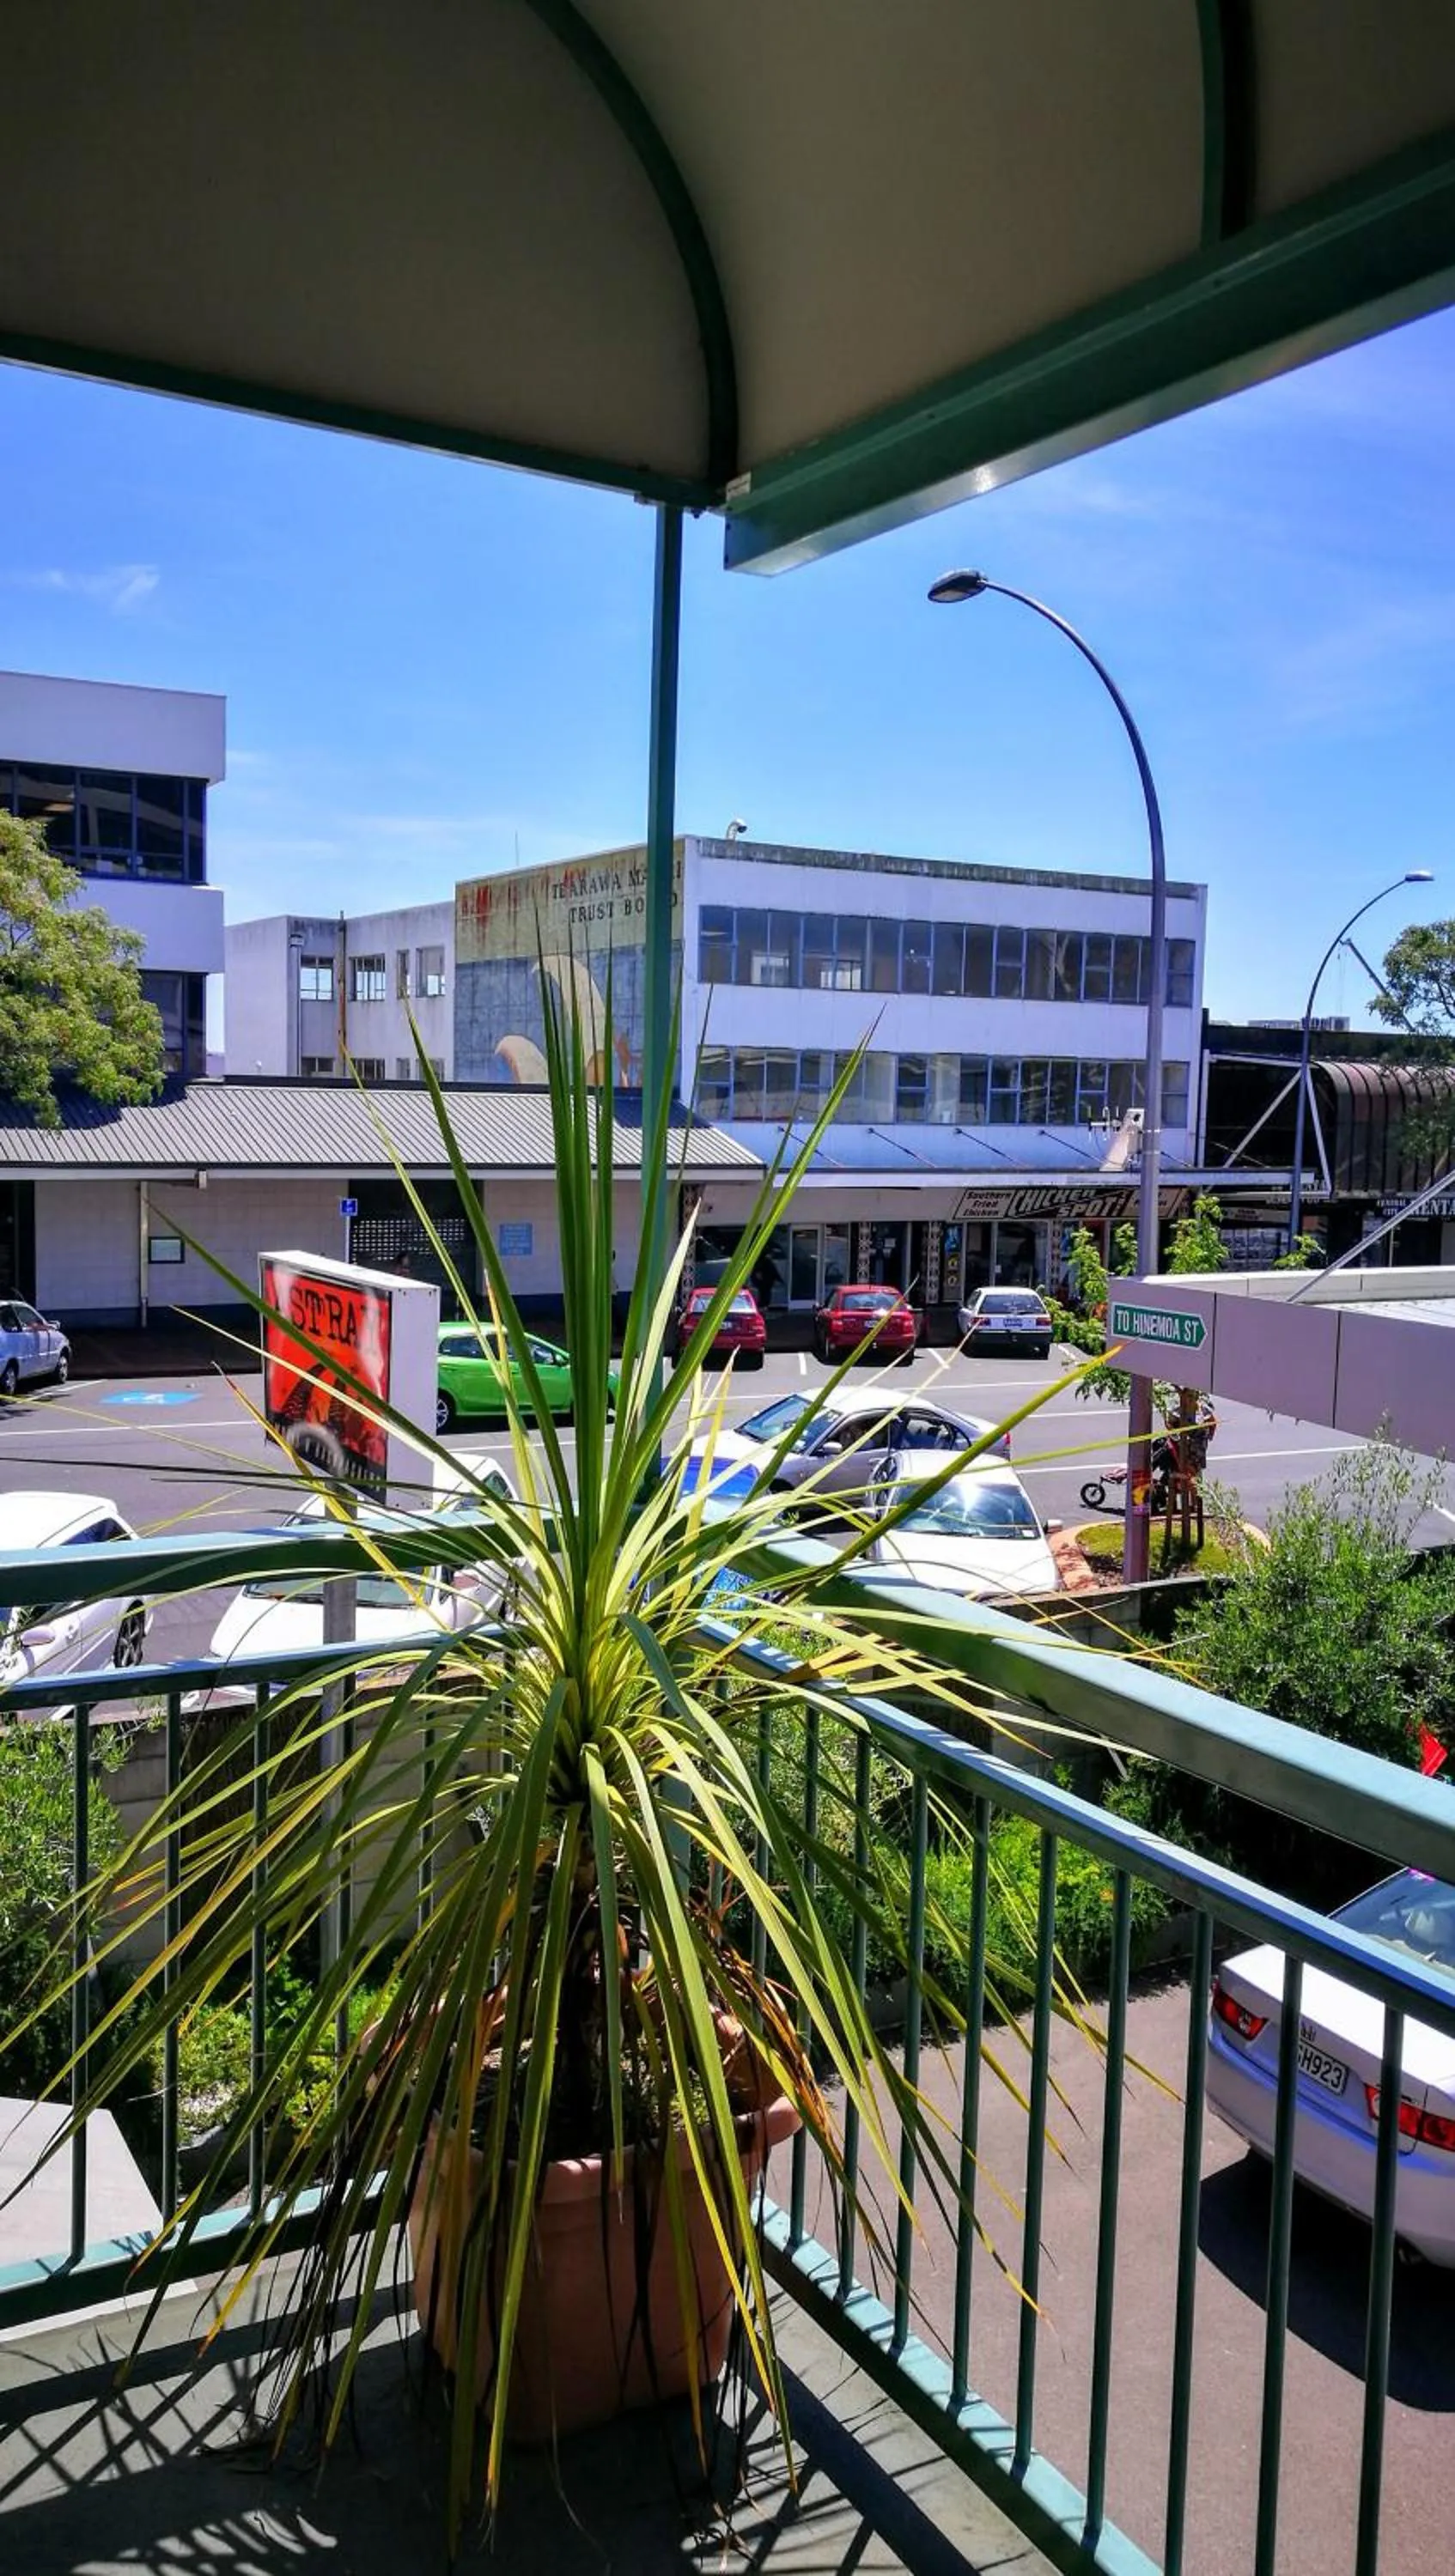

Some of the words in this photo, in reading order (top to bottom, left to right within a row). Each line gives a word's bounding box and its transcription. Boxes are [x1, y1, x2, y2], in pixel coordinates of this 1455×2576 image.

[569, 871, 622, 896] ARAWA
[569, 901, 613, 923] TRUST
[624, 892, 678, 916] BOD
[1117, 1310, 1129, 1332] TO
[1133, 1311, 1181, 1340] HINEMOA
[1184, 1320, 1199, 1343] ST
